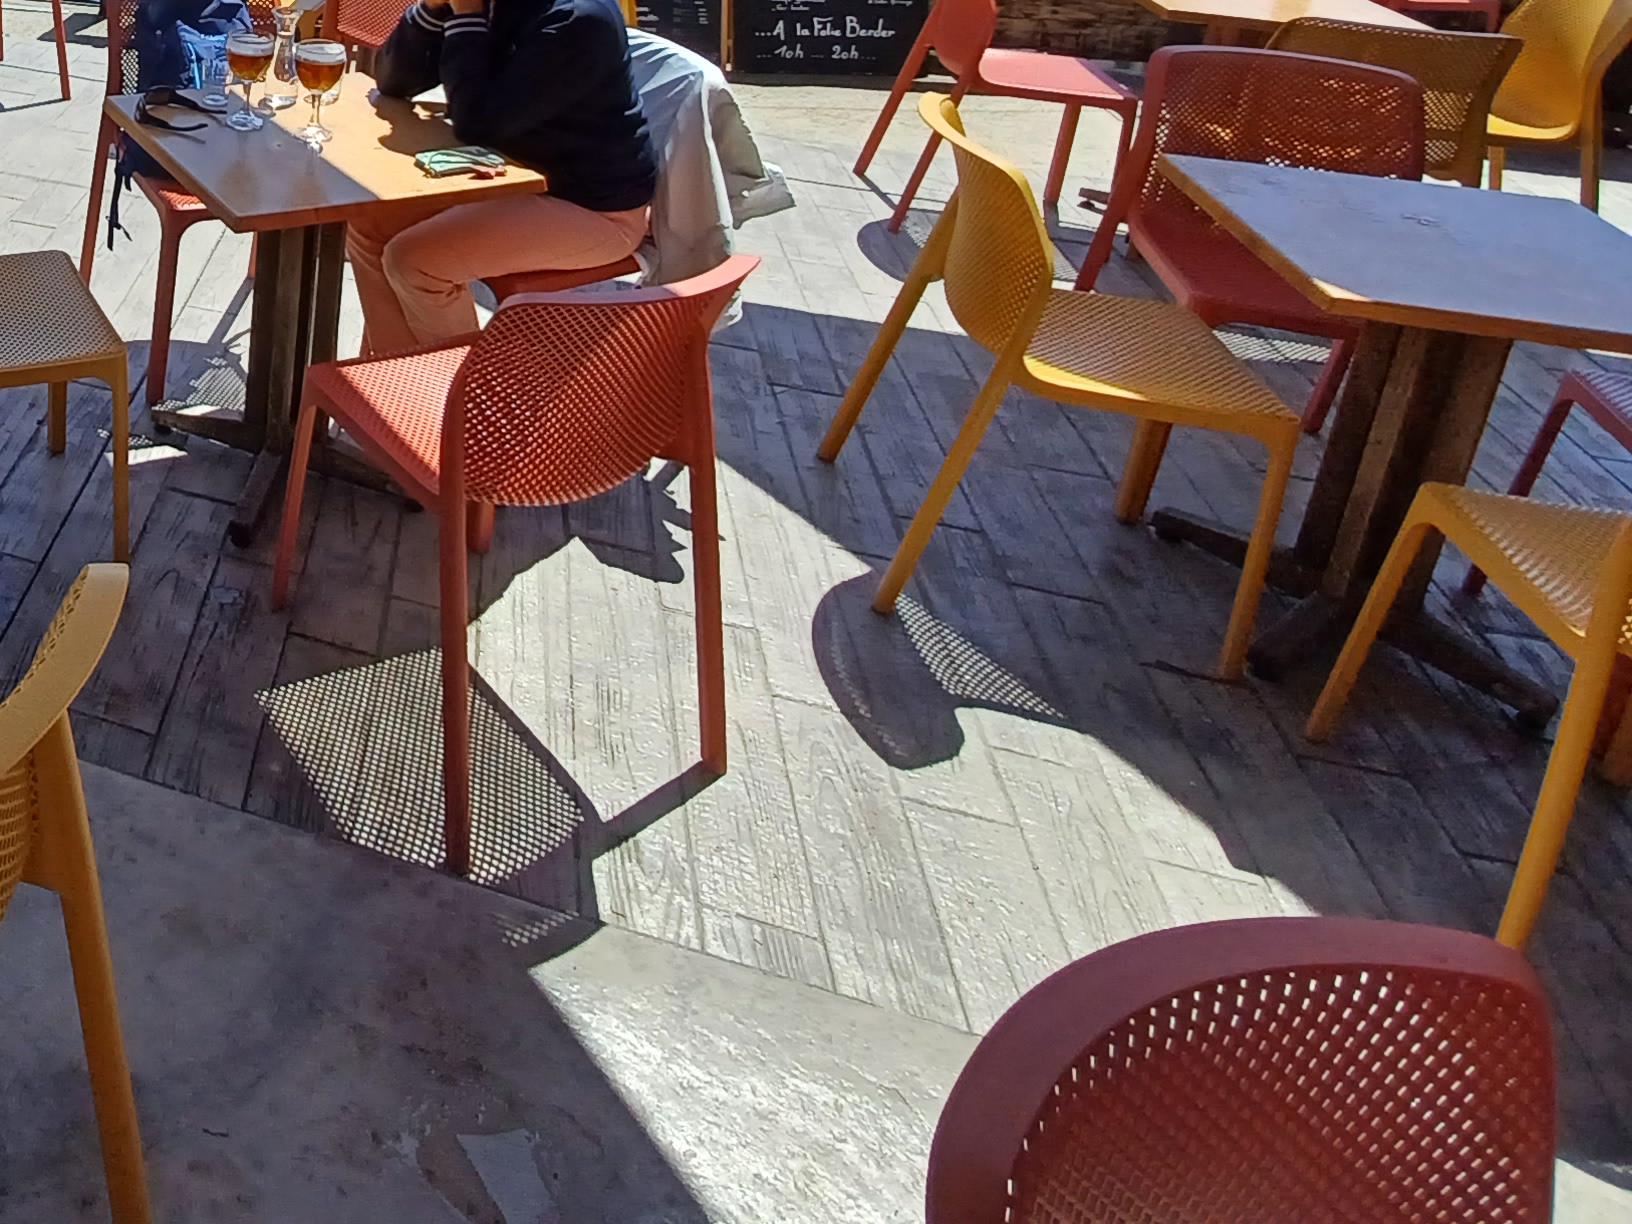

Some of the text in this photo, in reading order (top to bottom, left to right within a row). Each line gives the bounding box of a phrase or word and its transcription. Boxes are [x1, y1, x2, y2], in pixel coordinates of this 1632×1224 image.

[796, 22, 811, 36] la
[812, 16, 843, 37] Folie
[845, 15, 897, 38] Berder
